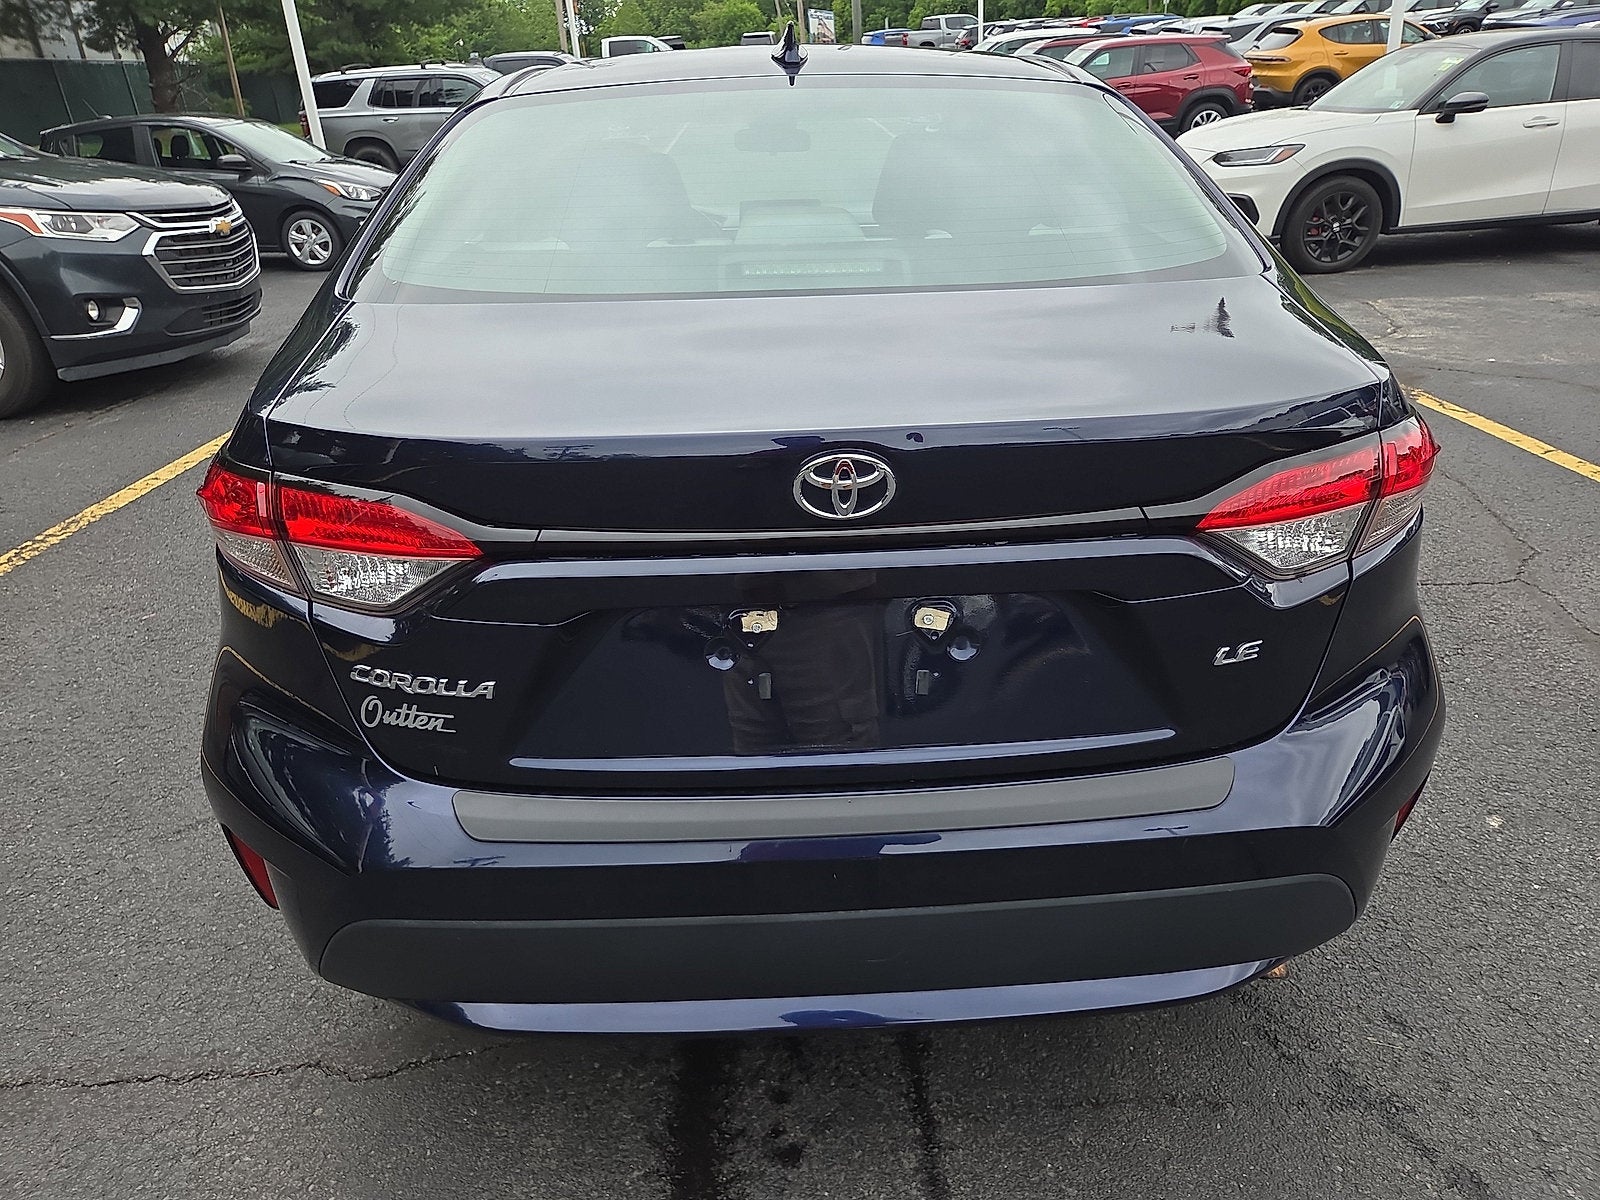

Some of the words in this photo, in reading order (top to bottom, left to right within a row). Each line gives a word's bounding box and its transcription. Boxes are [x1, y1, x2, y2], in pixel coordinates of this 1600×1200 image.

[1213, 640, 1263, 666] LE
[350, 664, 496, 700] COROLLA
[360, 695, 457, 733] Outten
